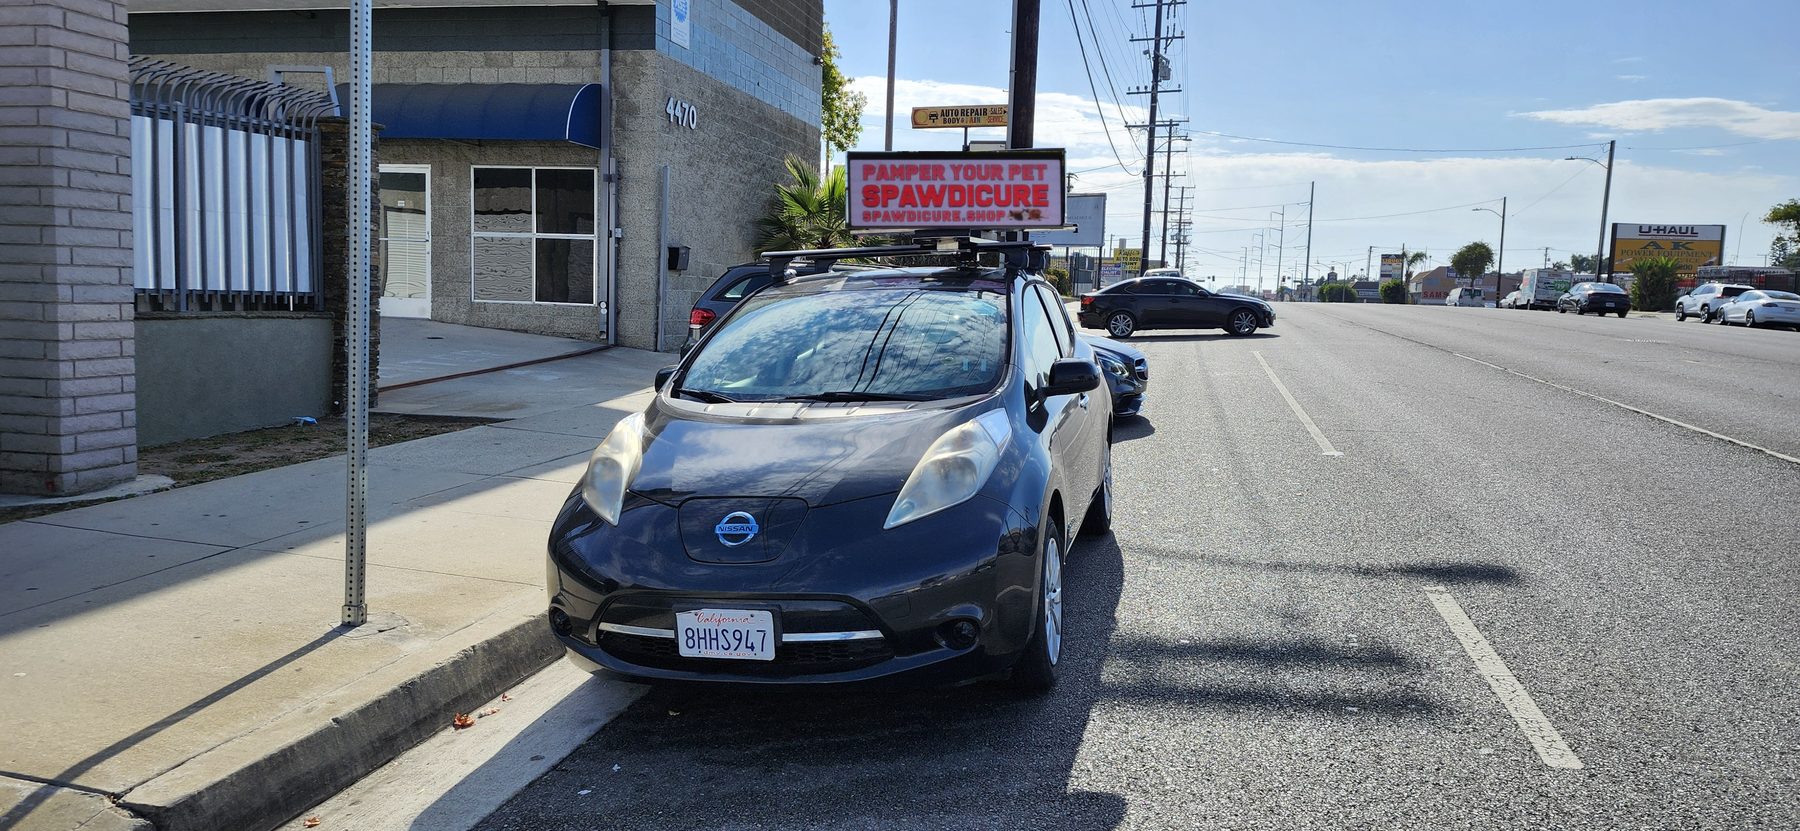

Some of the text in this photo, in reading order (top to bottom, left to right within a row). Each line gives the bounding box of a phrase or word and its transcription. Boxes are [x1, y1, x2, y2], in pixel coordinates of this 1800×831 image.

[666, 96, 697, 130] 4470
[940, 107, 988, 118] AUTO REPAIR
[862, 163, 1048, 182] PAMPER YOUR PET
[861, 184, 1050, 208] SPAWDICURE
[862, 210, 1006, 223] SPAWDICURE.SHOP
[1638, 225, 1699, 235] U-HAUL
[1621, 249, 1713, 258] POWER EQUIPMENT
[697, 612, 750, 626] California
[685, 627, 766, 652] 8HHS947
